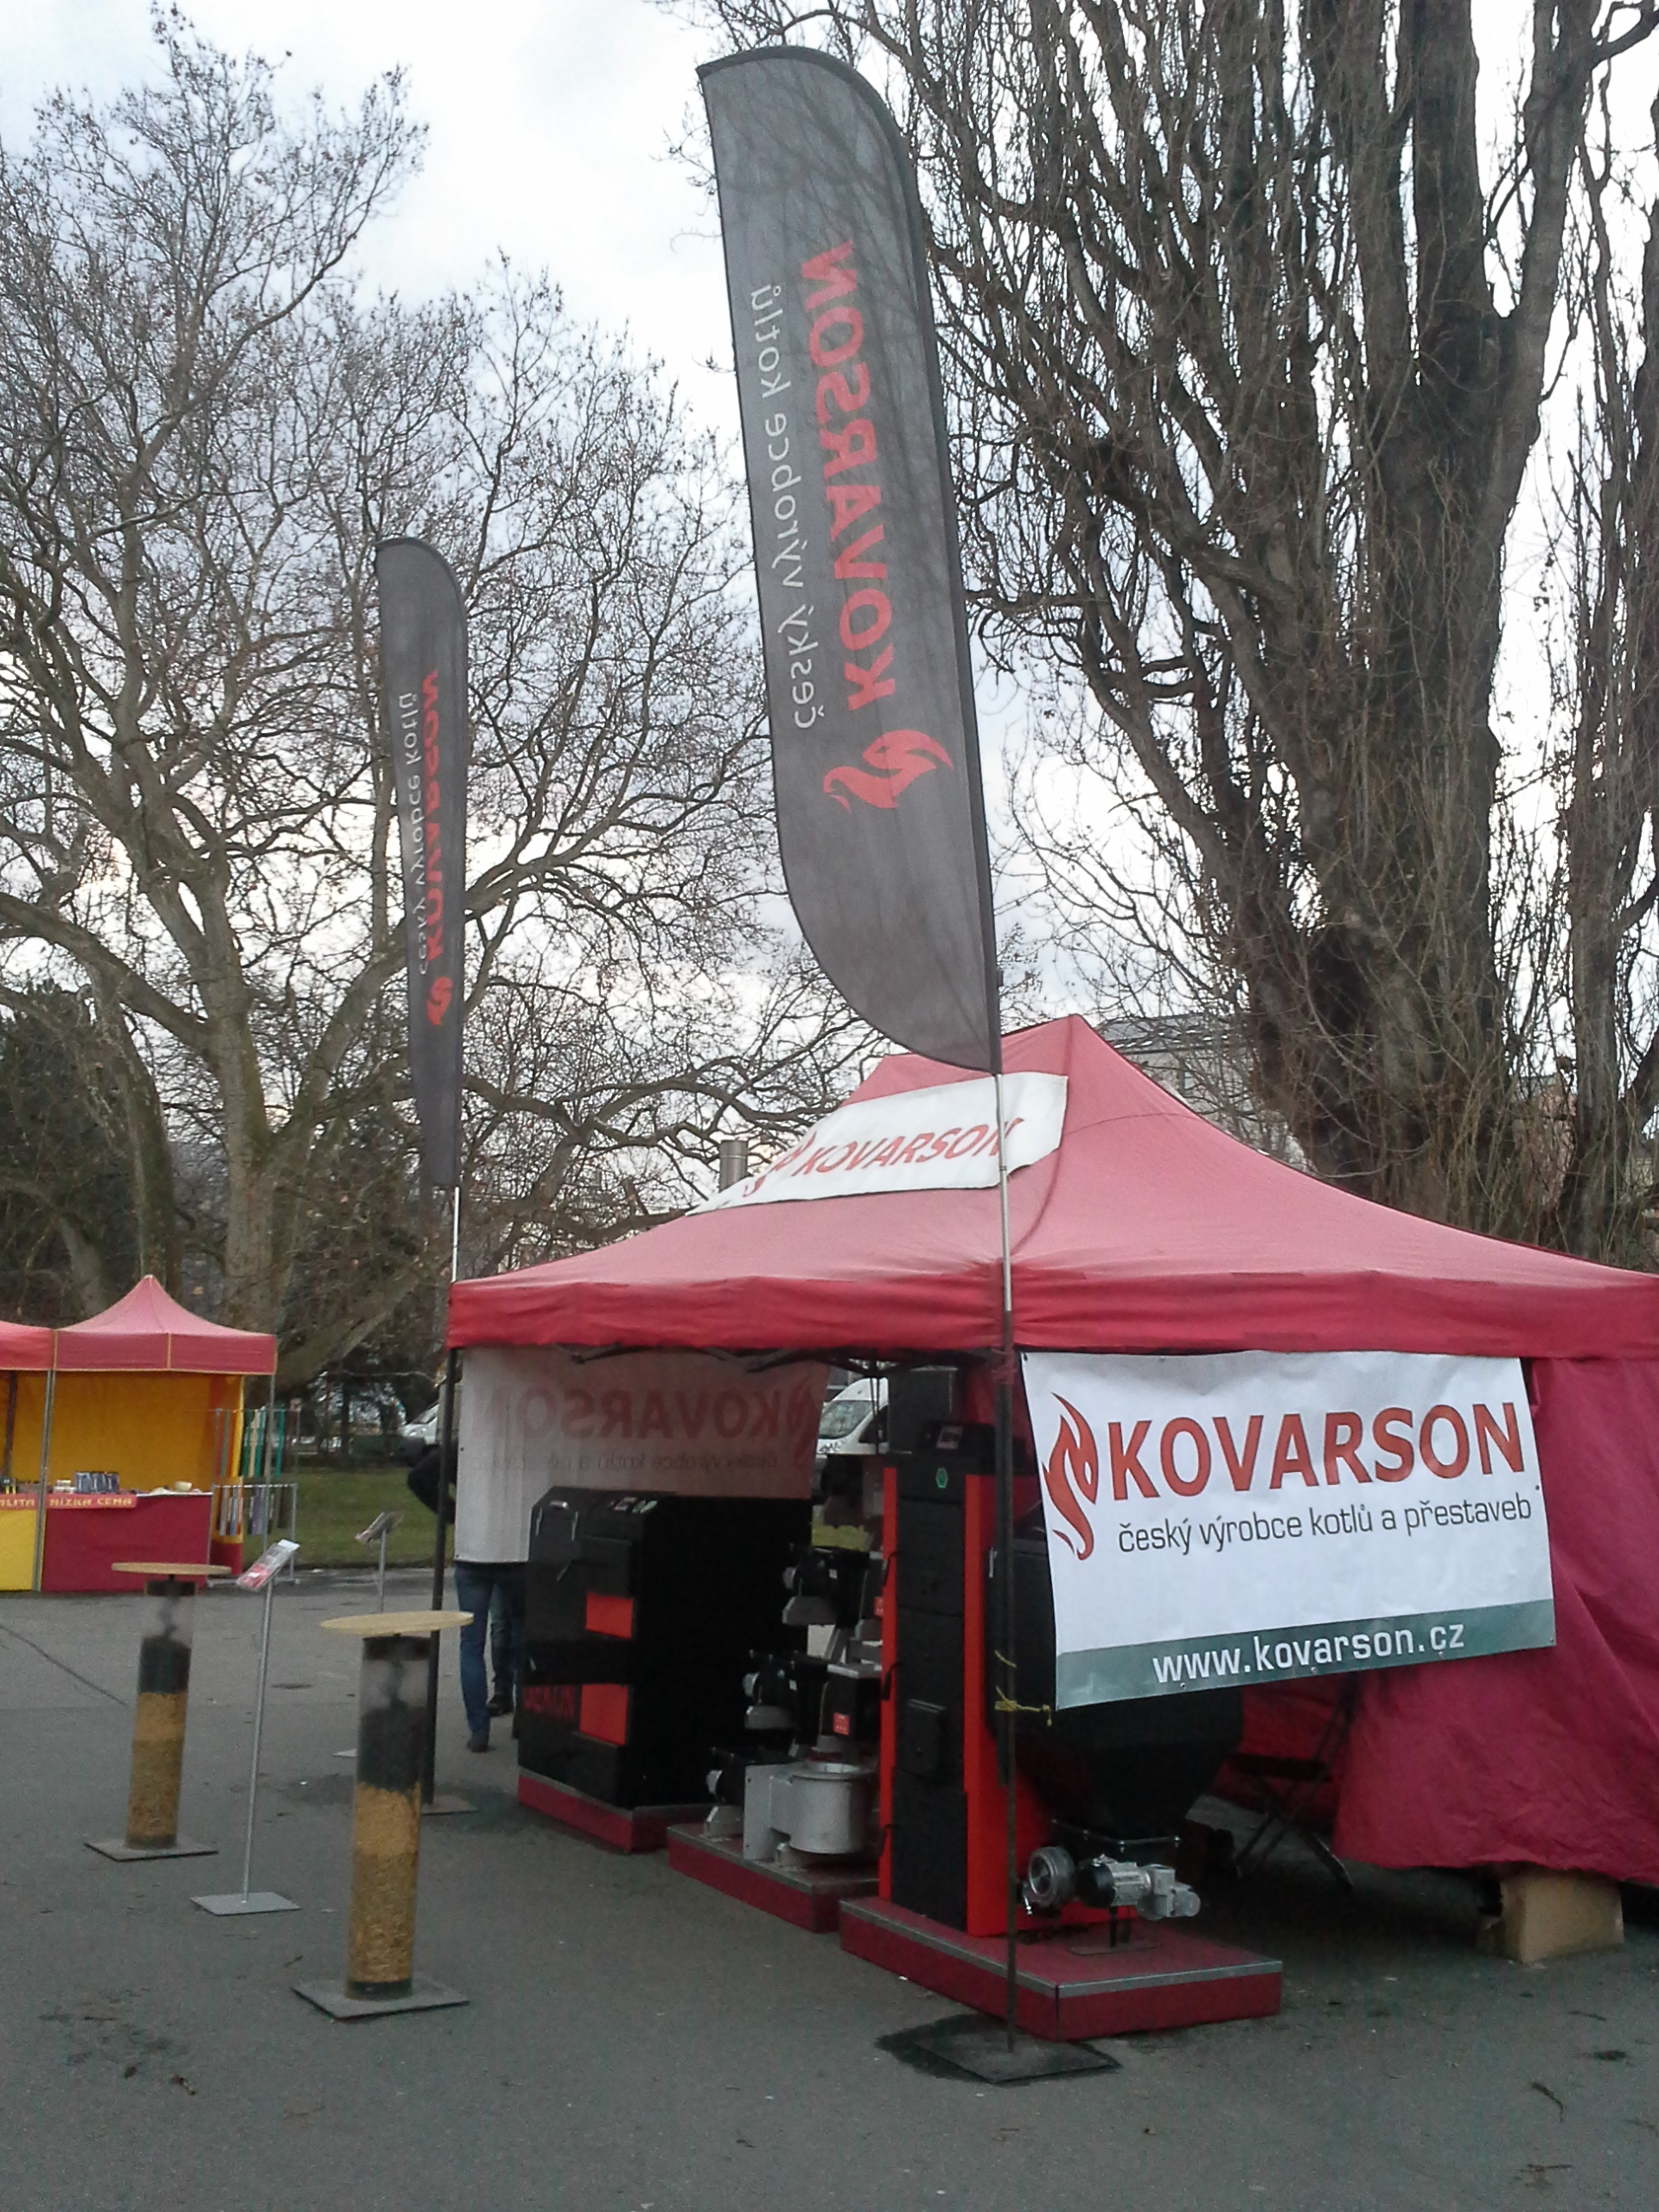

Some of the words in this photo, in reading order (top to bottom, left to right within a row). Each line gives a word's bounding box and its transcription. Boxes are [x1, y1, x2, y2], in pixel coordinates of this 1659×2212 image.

[1107, 1401, 1526, 1501] KOVARSON
[1118, 1516, 1192, 1555] český
[1201, 1514, 1303, 1553] výrobce
[1310, 1502, 1374, 1537] kotlů
[1381, 1511, 1397, 1530] a
[1403, 1492, 1533, 1537] přestaveb
[1152, 1621, 1465, 1686] www.kovarson.cz
